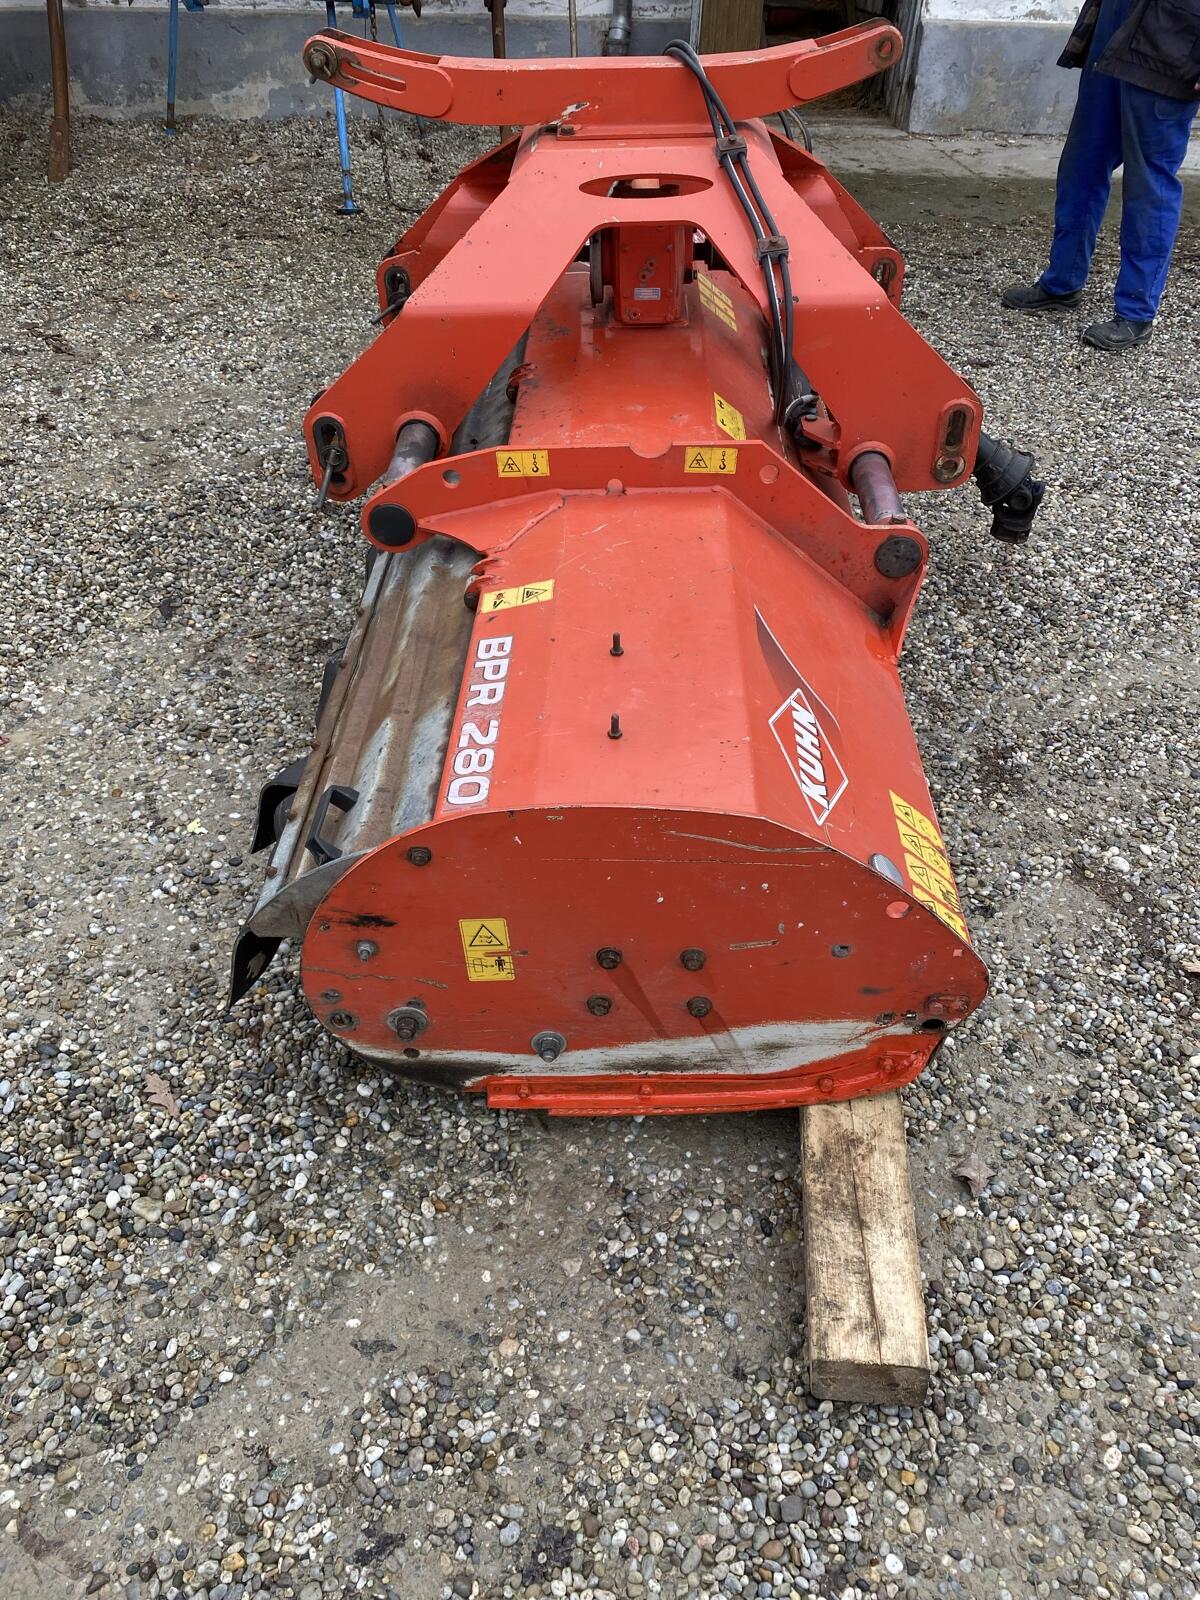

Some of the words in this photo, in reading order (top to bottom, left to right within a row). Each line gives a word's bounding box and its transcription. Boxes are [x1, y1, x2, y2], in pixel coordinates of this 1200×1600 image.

[466, 636, 513, 708] BPR
[447, 720, 499, 805] 280
[790, 699, 830, 810] KUHN
